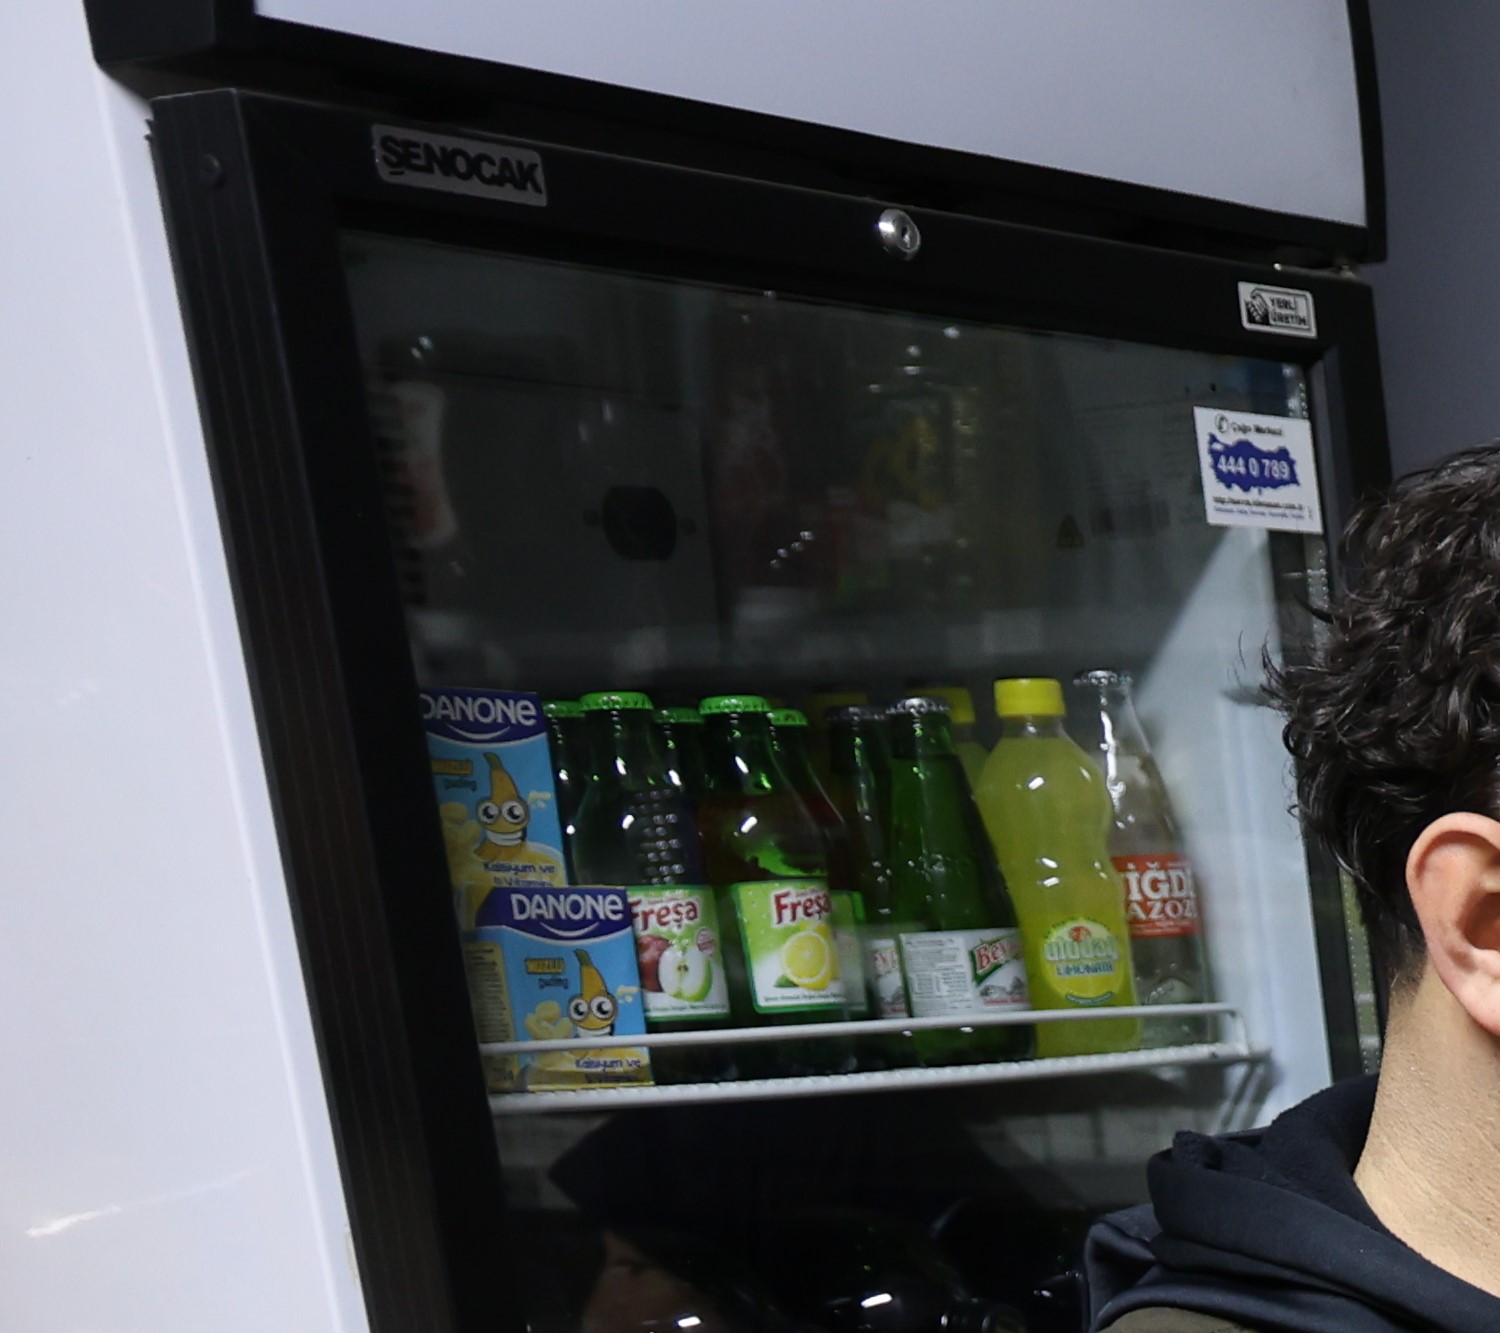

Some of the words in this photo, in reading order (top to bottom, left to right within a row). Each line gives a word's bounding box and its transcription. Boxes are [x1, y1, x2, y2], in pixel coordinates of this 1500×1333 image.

[380, 135, 543, 194] ŞENOCAK
[1216, 455, 1246, 476] 444
[1262, 457, 1291, 481] 789
[419, 693, 538, 728] DANONE
[510, 892, 626, 922] DANONE
[774, 890, 833, 926] Freşa
